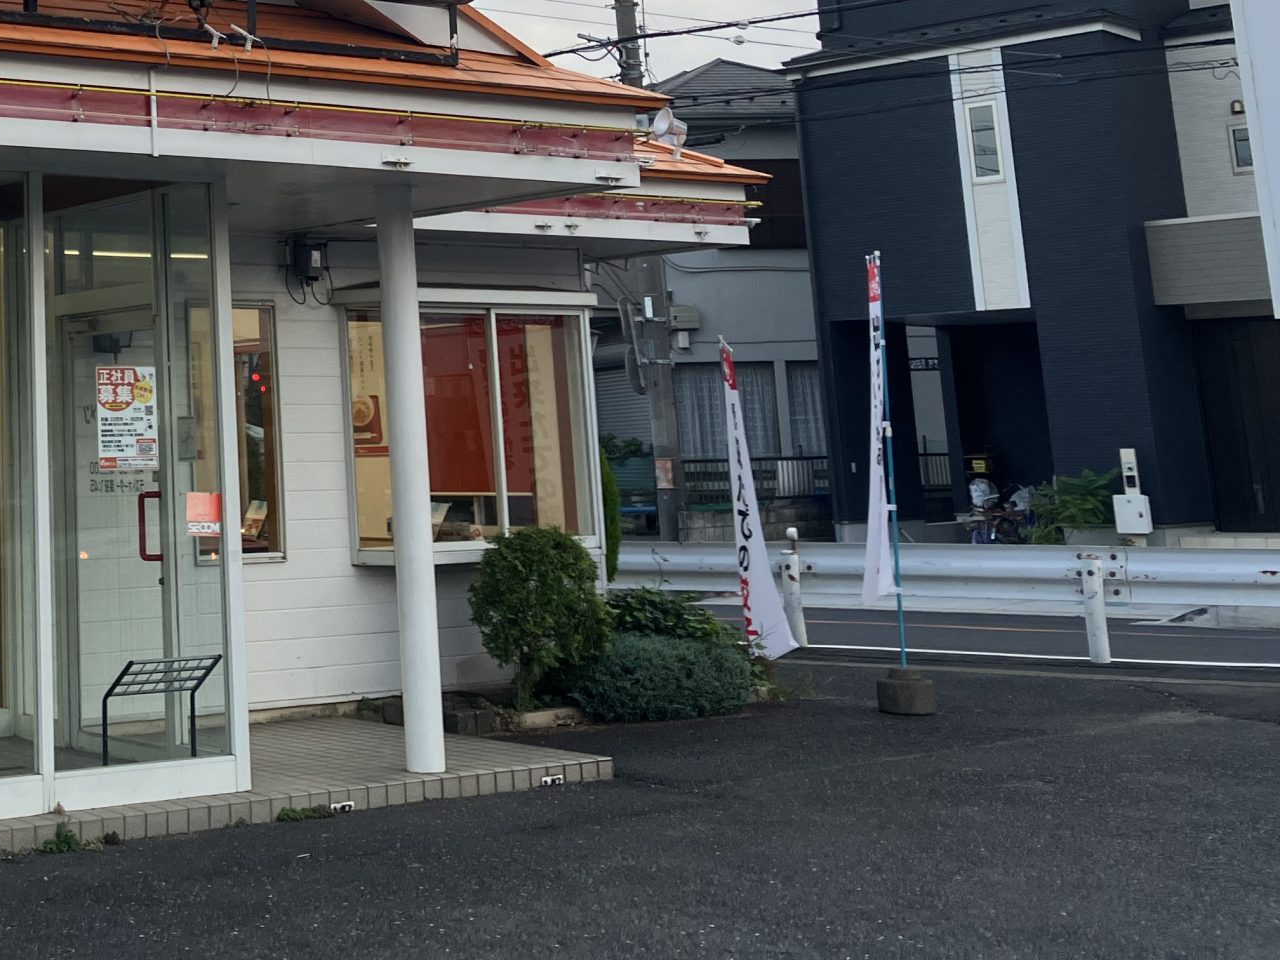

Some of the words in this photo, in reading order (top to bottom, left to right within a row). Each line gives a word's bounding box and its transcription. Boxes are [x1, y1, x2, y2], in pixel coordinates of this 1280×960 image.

[98, 369, 135, 384] 正社員
[98, 385, 133, 403] 募集
